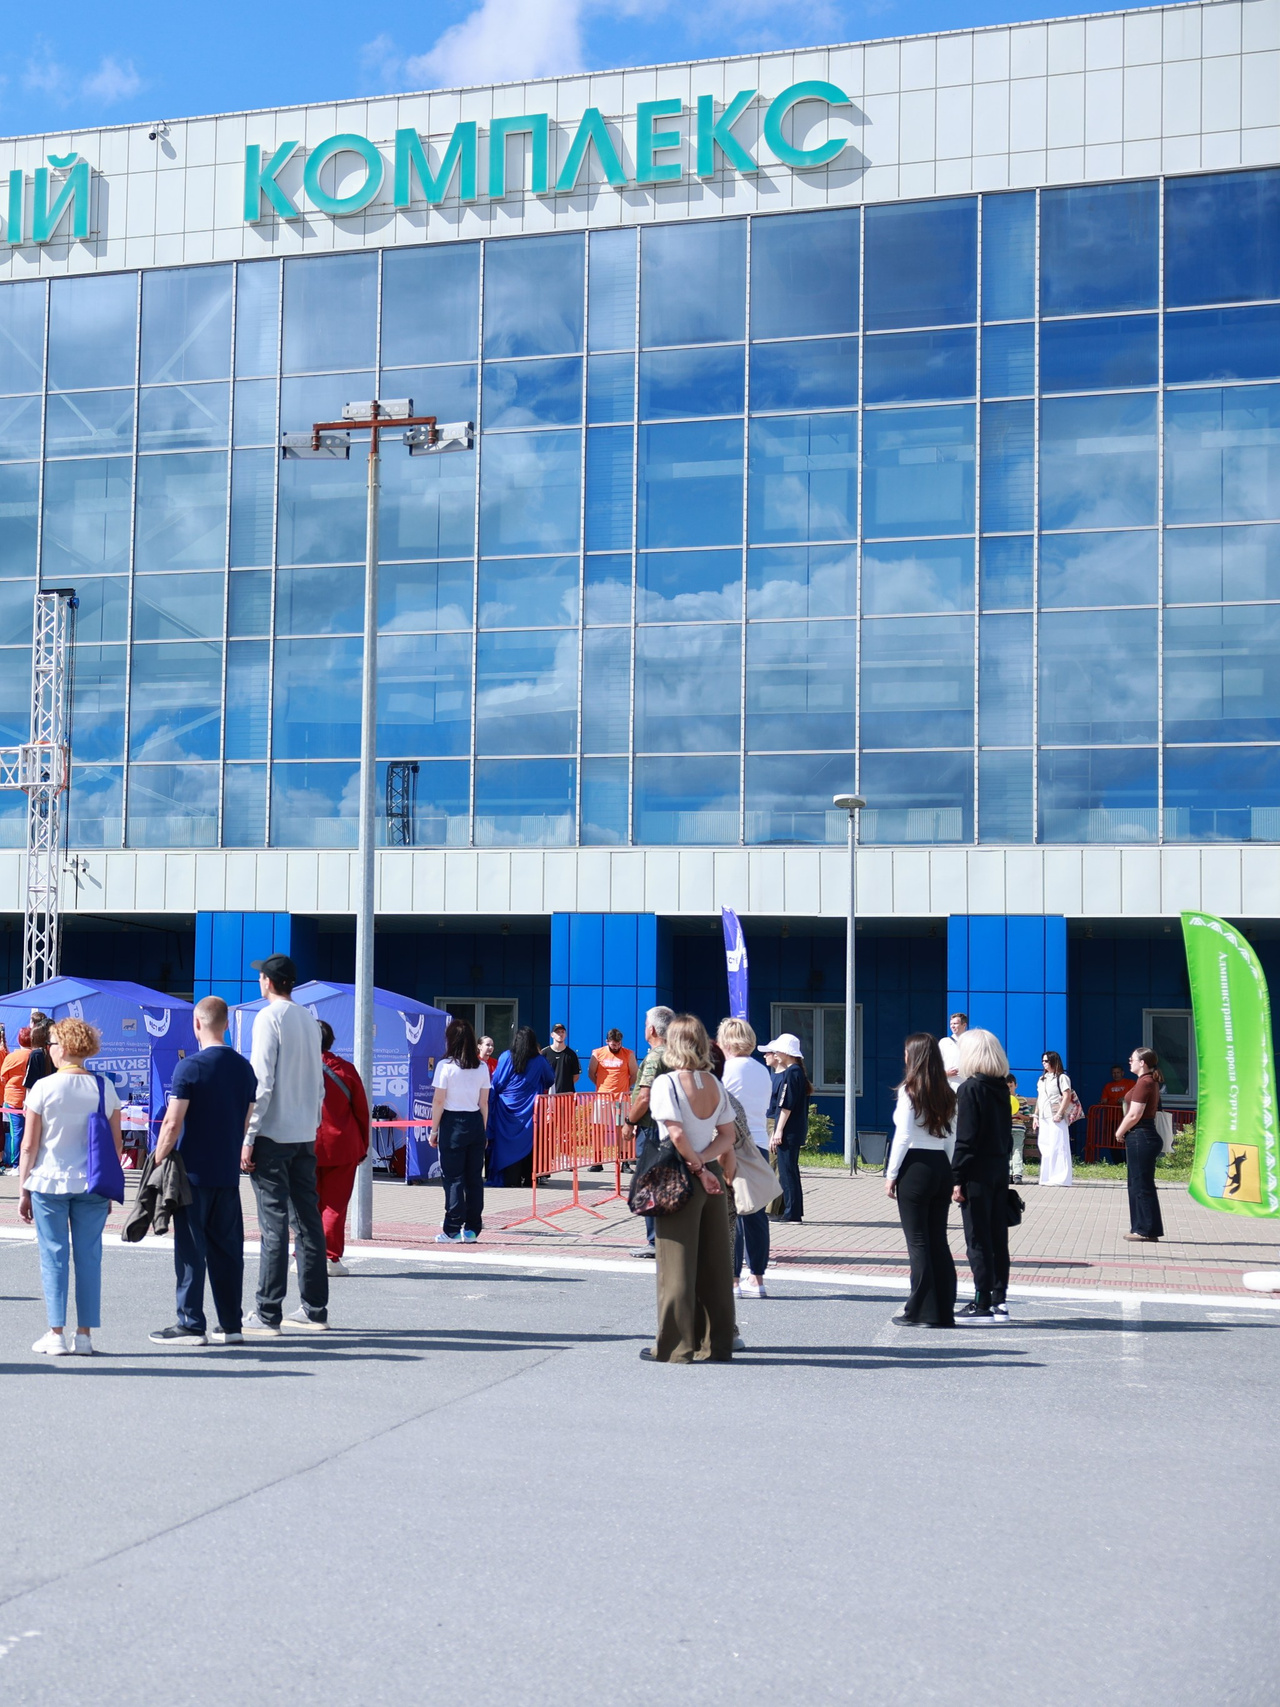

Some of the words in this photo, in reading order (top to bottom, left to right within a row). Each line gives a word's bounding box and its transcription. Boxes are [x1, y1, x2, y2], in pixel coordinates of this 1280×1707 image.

[244, 79, 852, 225] КОМПЛЕКС
[1219, 951, 1234, 1042] Администрация
[1225, 1045, 1237, 1082] города
[1230, 1085, 1239, 1131] Сургута
